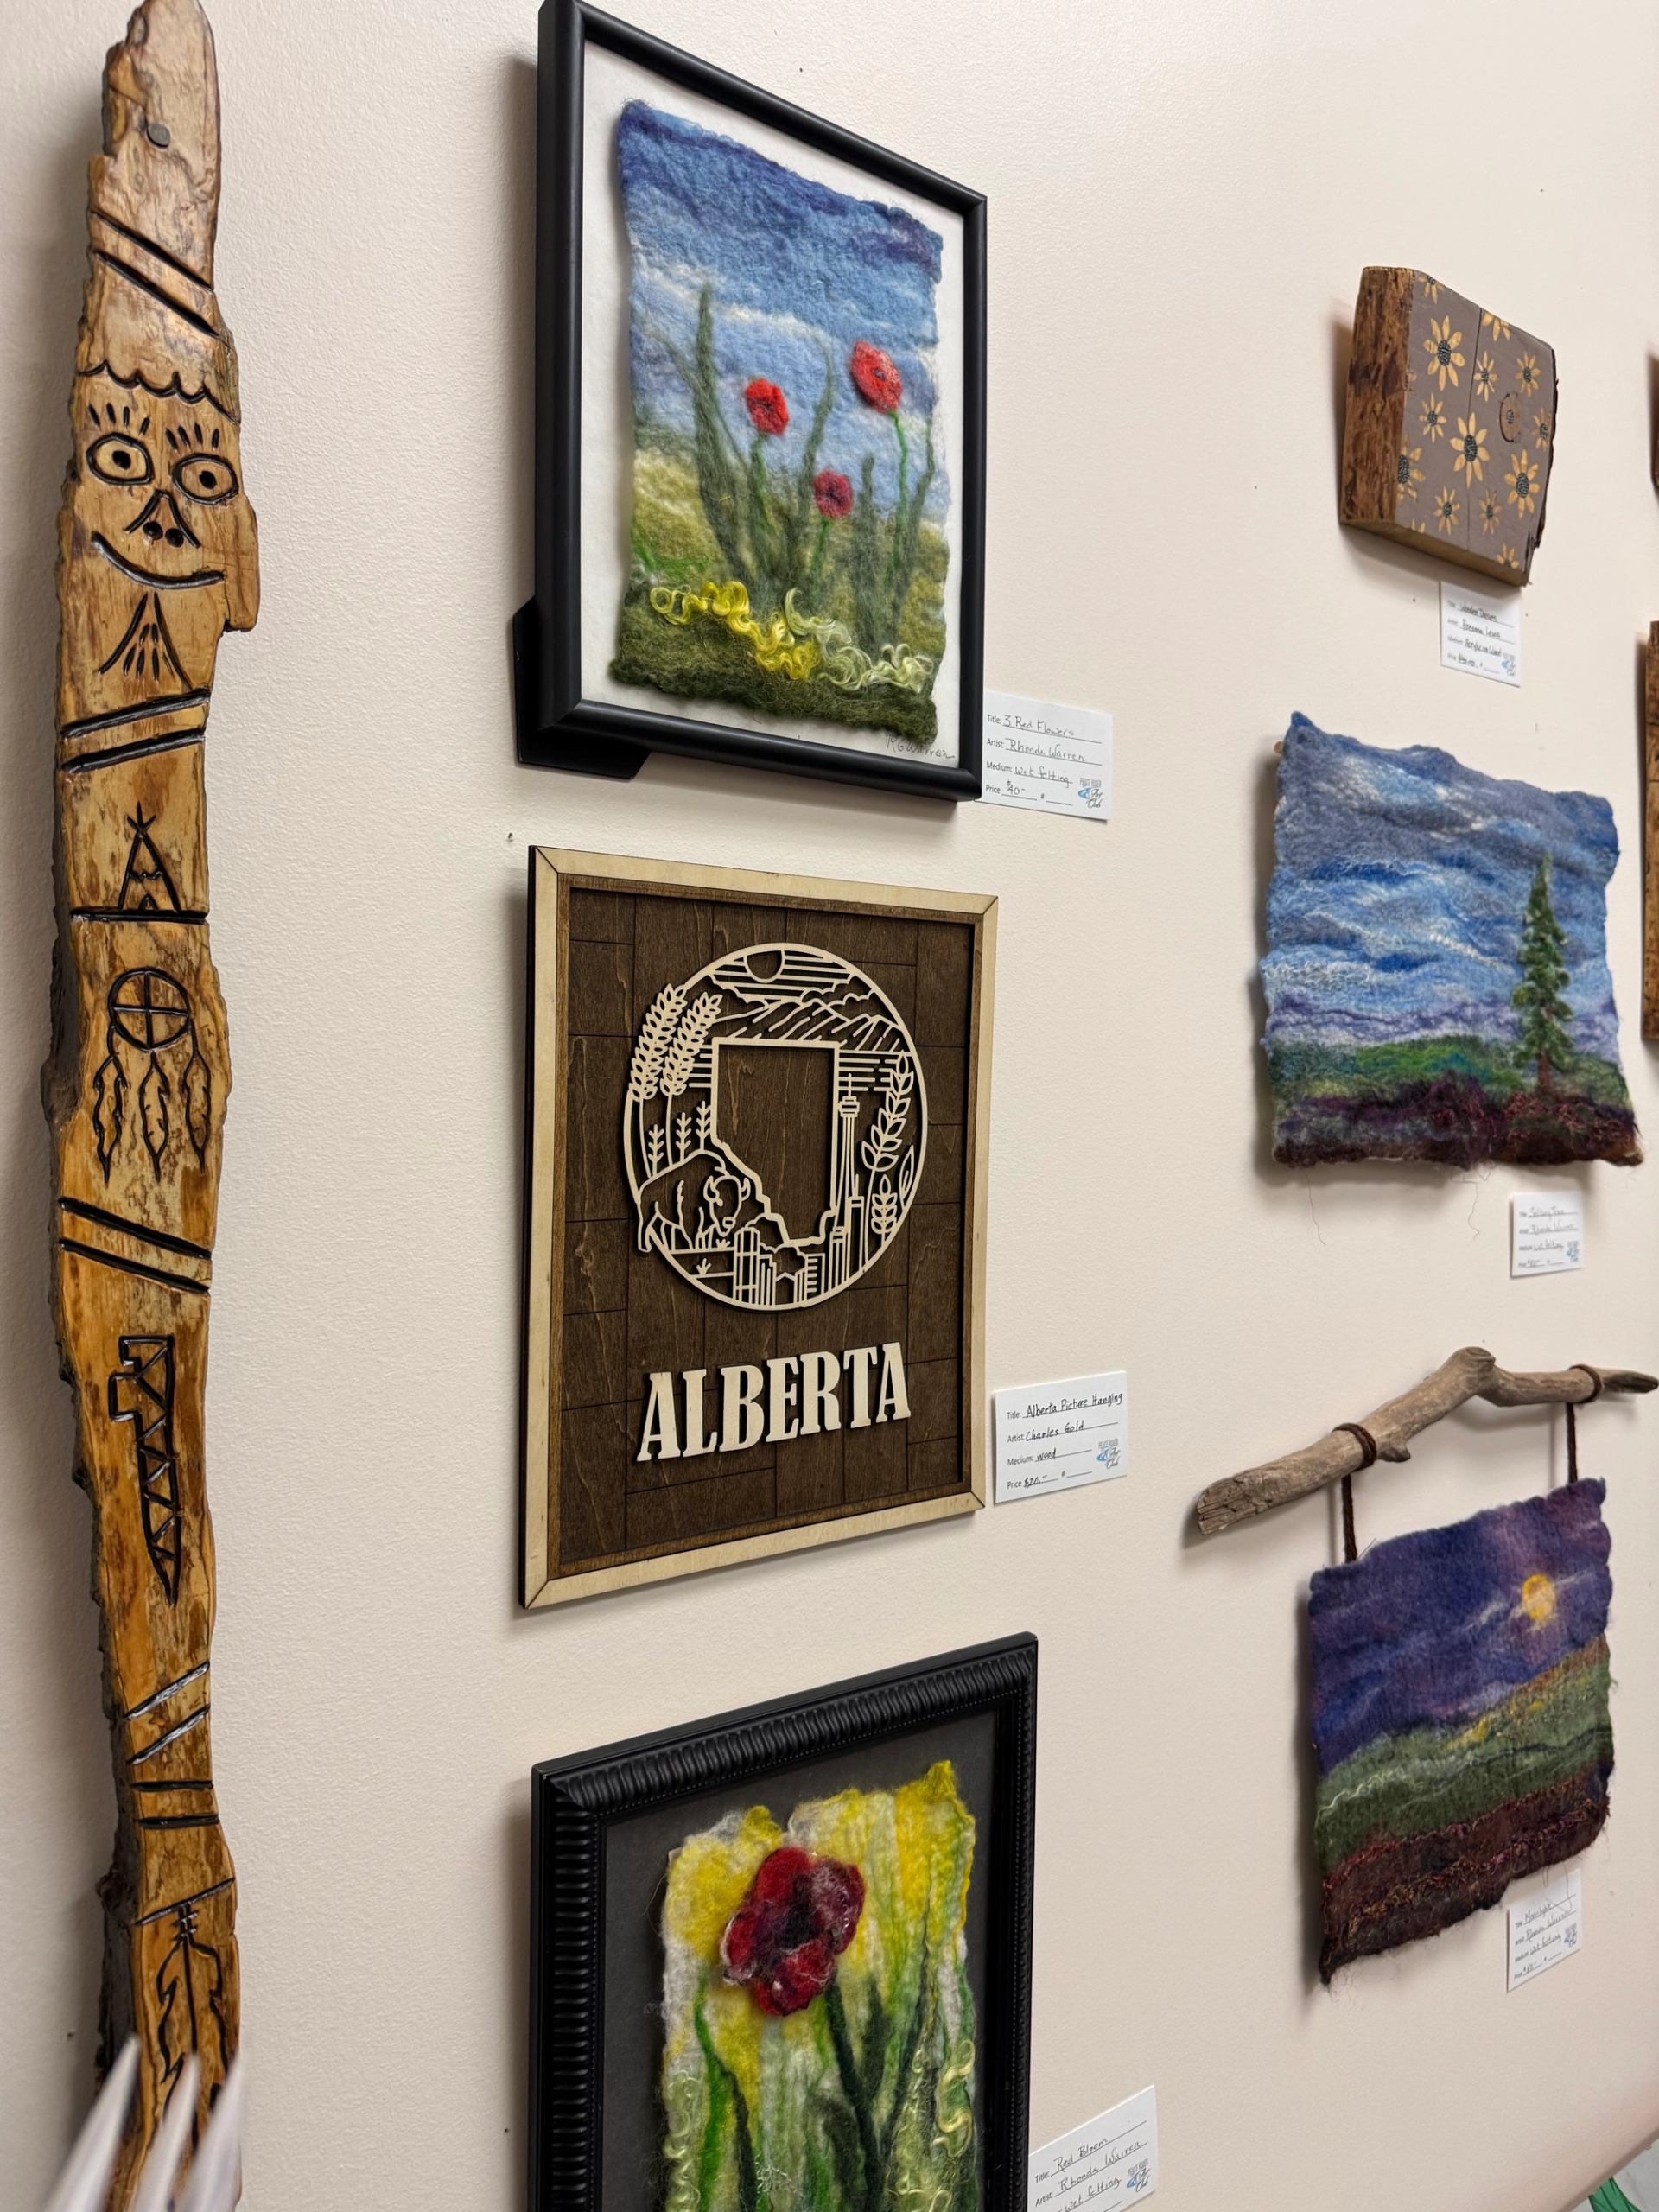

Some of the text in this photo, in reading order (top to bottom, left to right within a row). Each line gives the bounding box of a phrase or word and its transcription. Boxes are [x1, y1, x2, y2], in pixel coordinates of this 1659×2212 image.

[987, 714, 1074, 735] Title: 3 Red Flowers
[987, 738, 1085, 761] Artist: Rhonda Warren
[986, 761, 1013, 773] Medium:
[986, 784, 1001, 794] Price
[636, 1342, 911, 1462] ALBERTA
[1026, 1402, 1057, 1418] Alberta
[1061, 1397, 1088, 1411] Picture
[1092, 1393, 1123, 1408] Hanging
[1026, 1427, 1059, 1441] Charles
[1065, 1420, 1084, 1433] Gold
[1007, 1455, 1033, 1466] Medium:
[1007, 1480, 1022, 1489] Price
[1035, 2138, 1108, 2183] Title: Red Bloom
[1058, 2165, 1099, 2190] Rhonda
[1105, 2141, 1141, 2164] Warren
